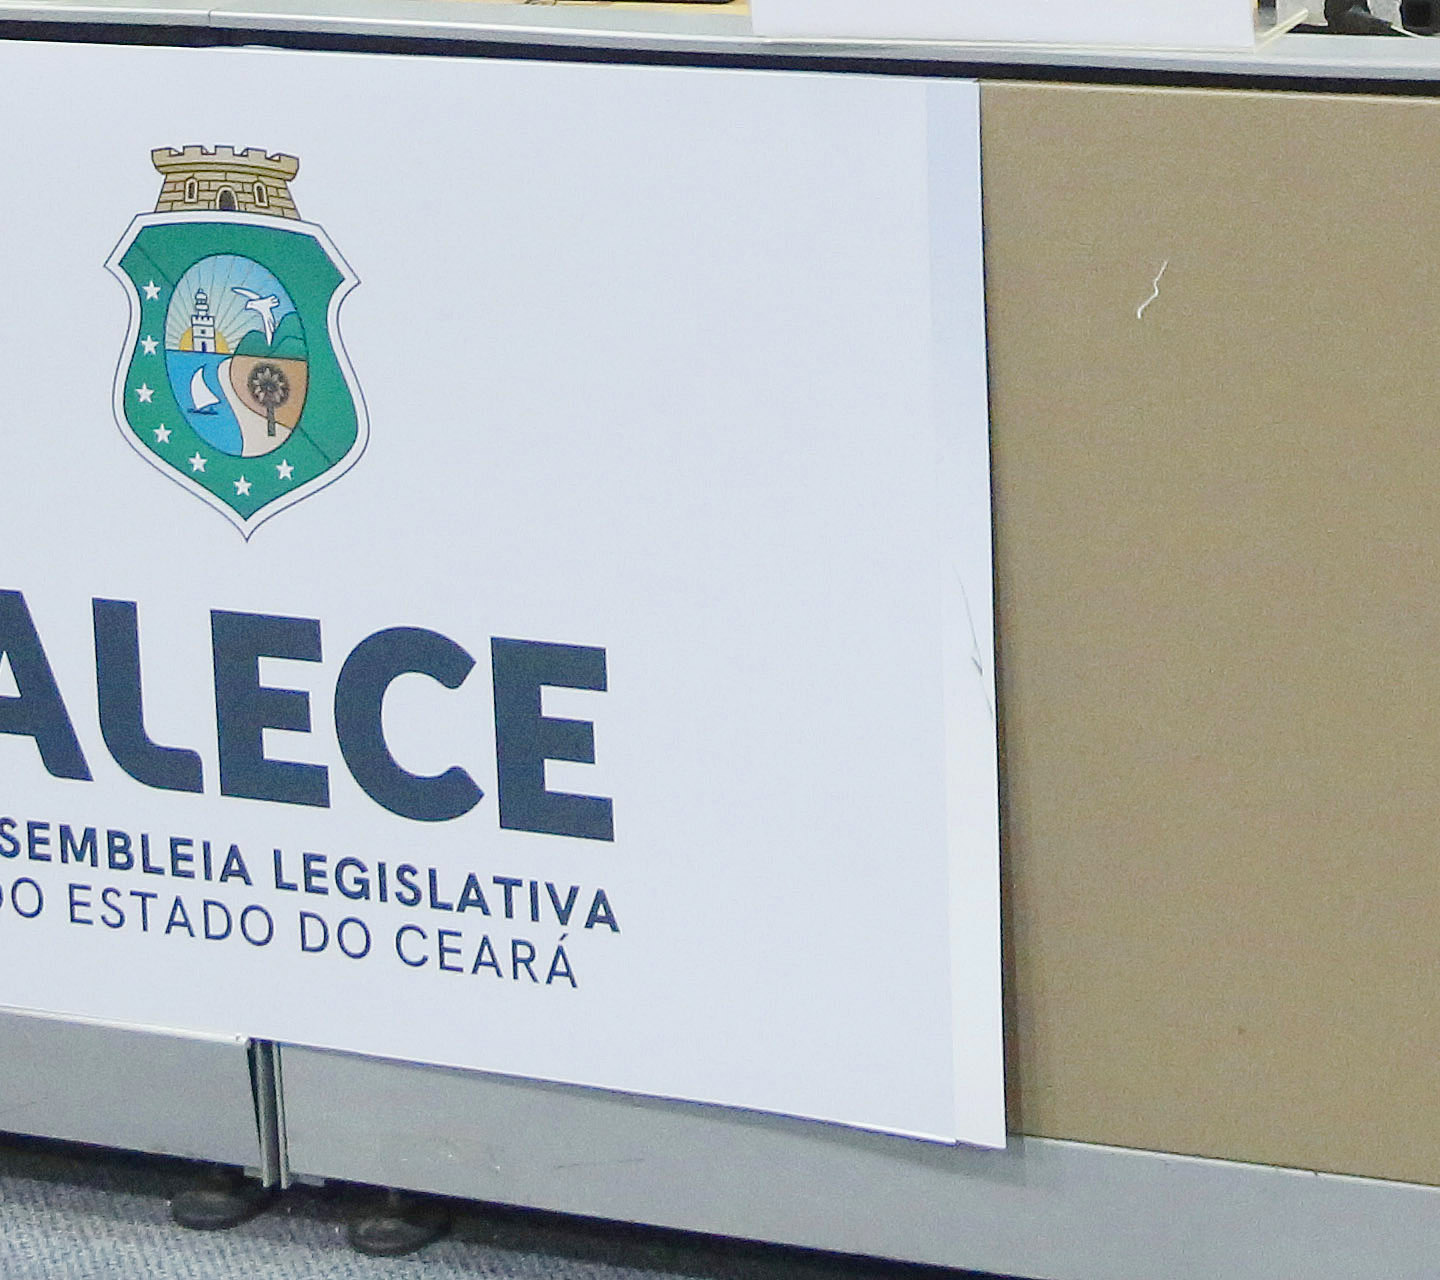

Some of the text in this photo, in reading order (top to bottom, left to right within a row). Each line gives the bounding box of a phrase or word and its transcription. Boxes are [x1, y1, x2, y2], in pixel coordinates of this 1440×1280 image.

[68, 883, 274, 947] ESTADO
[299, 911, 372, 960] DO
[395, 925, 579, 989] CEARÁ
[273, 848, 621, 933] LEGISLATIVA
